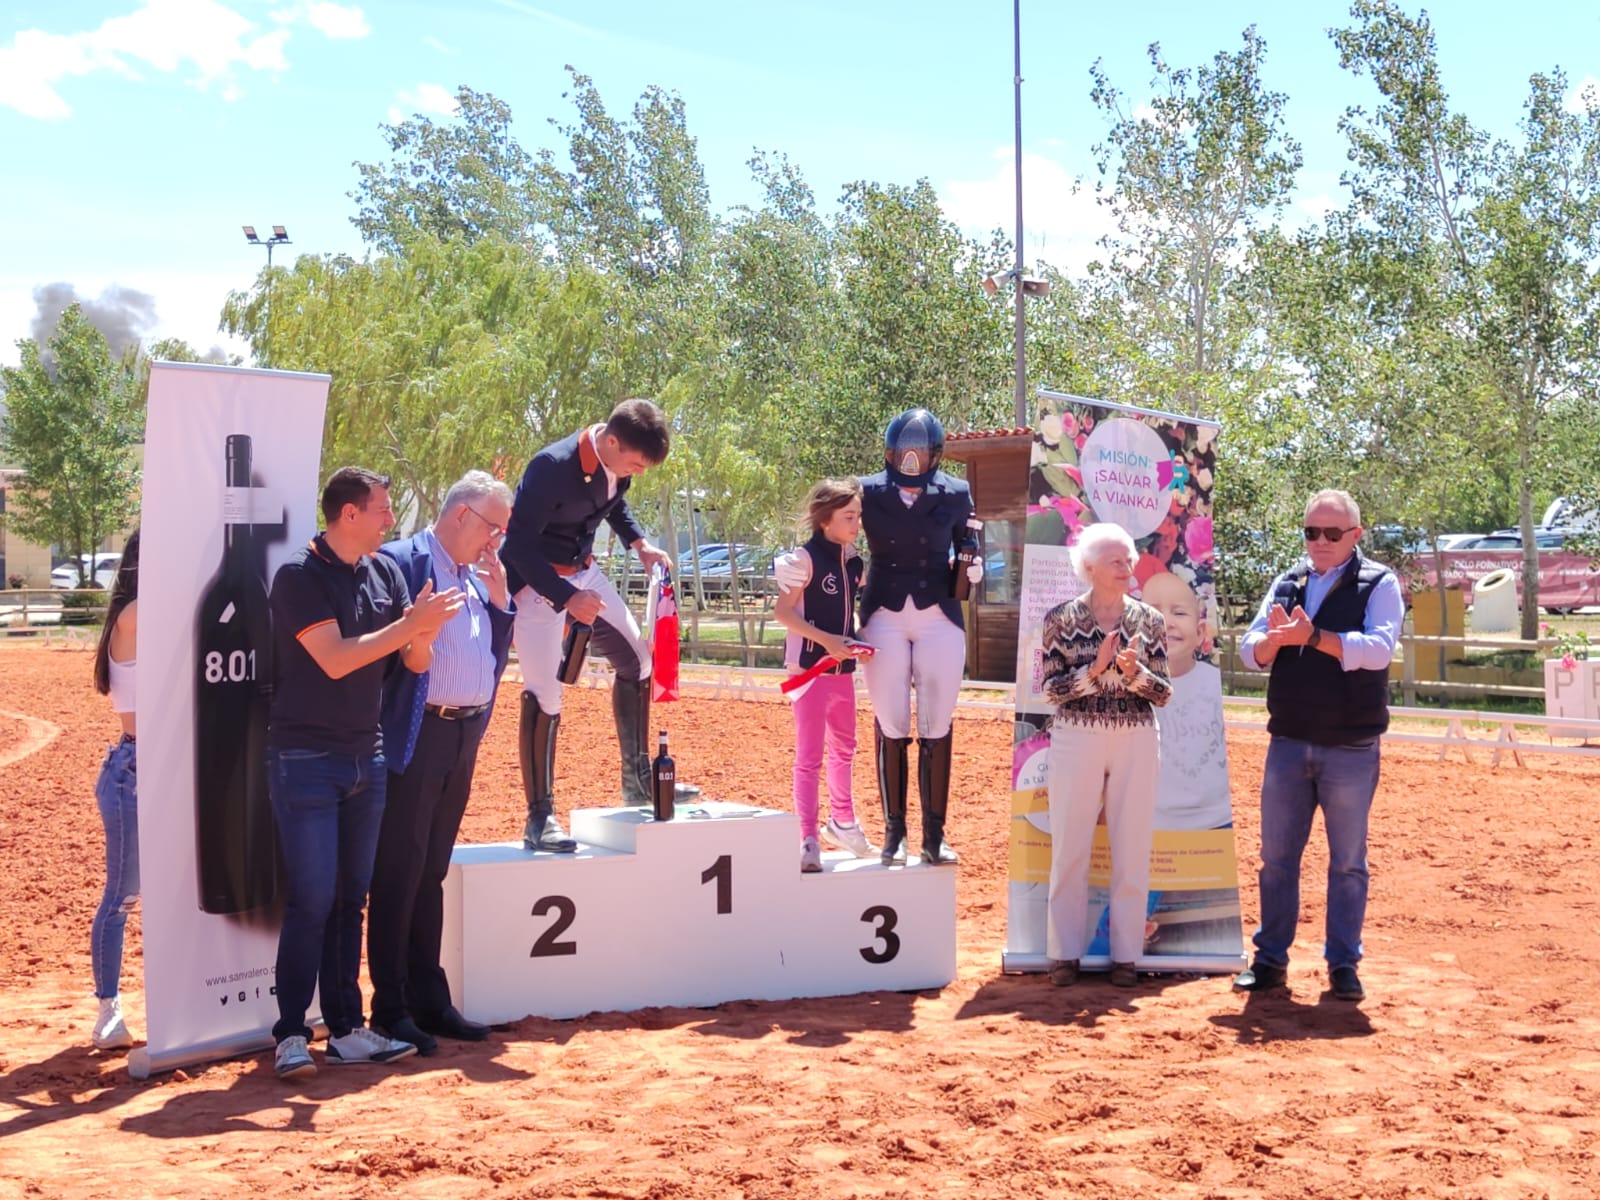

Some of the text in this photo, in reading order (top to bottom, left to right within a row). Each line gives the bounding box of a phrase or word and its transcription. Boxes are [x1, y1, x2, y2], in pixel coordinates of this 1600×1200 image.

[1092, 488, 1159, 511] A VIANKA!
[1095, 469, 1152, 489] ¡SALVAR
[701, 854, 733, 915] 1
[530, 895, 577, 957] 2
[859, 905, 901, 964] 3
[205, 966, 277, 987] www.sanvalero.c
